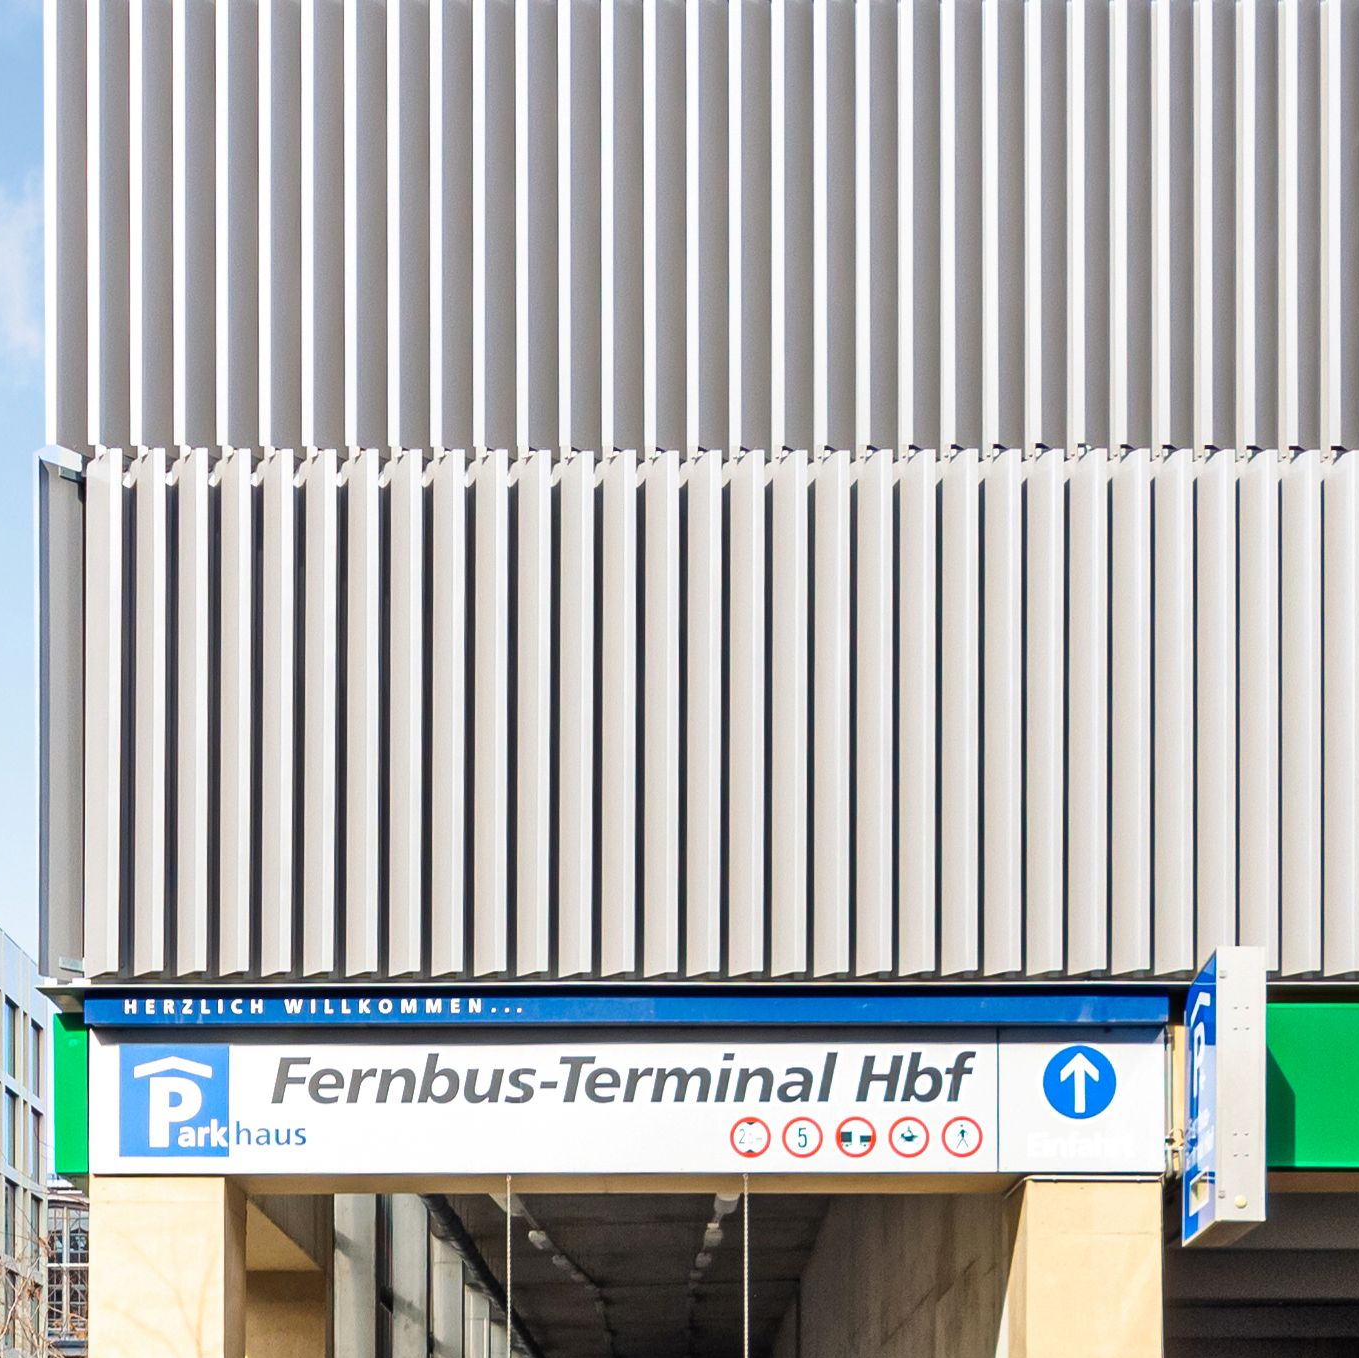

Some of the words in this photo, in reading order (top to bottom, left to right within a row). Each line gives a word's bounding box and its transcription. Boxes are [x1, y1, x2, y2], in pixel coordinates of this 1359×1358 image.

[123, 998, 264, 1015] HERZLICH
[283, 997, 523, 1015] WILLKOMMEN...
[270, 1052, 839, 1104] Fernbus-Terminal
[855, 1051, 977, 1103] Hbf
[148, 1076, 307, 1149] Parkhaus
[797, 1127, 808, 1148] 5
